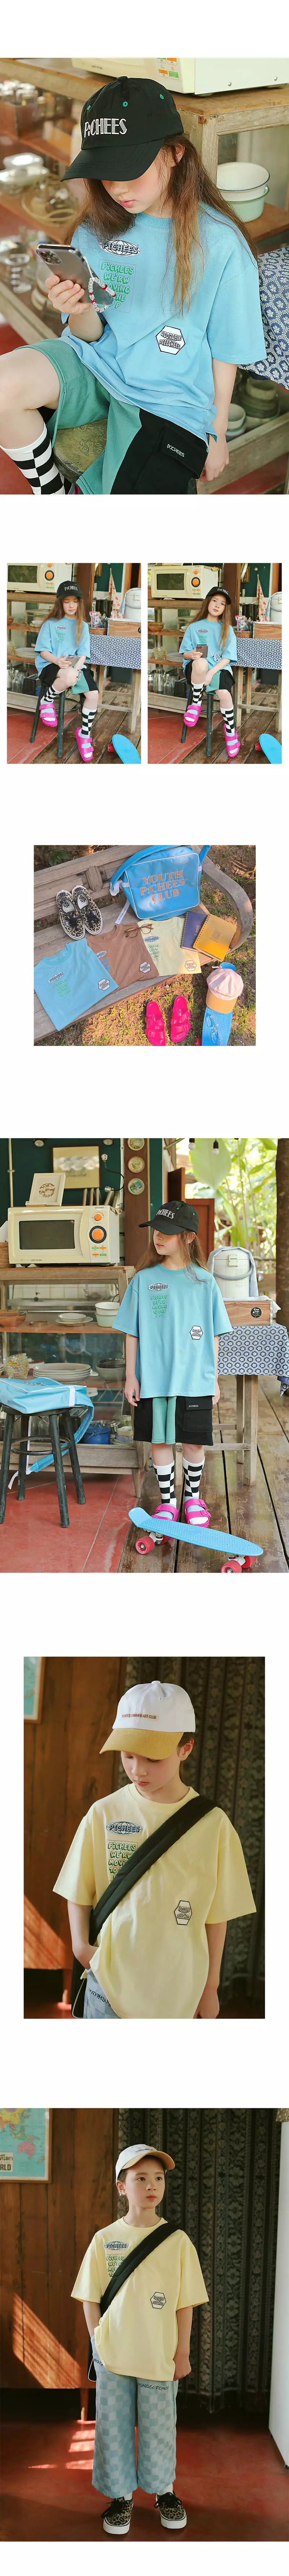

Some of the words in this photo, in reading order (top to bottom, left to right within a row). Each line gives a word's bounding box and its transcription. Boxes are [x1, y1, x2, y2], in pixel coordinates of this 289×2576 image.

[102, 242, 138, 254] PICHEES
[160, 331, 182, 341] ADORABLE
[142, 870, 184, 885] YOUTH
[151, 889, 180, 902] CLUB
[109, 1824, 140, 1832] PICHEES
